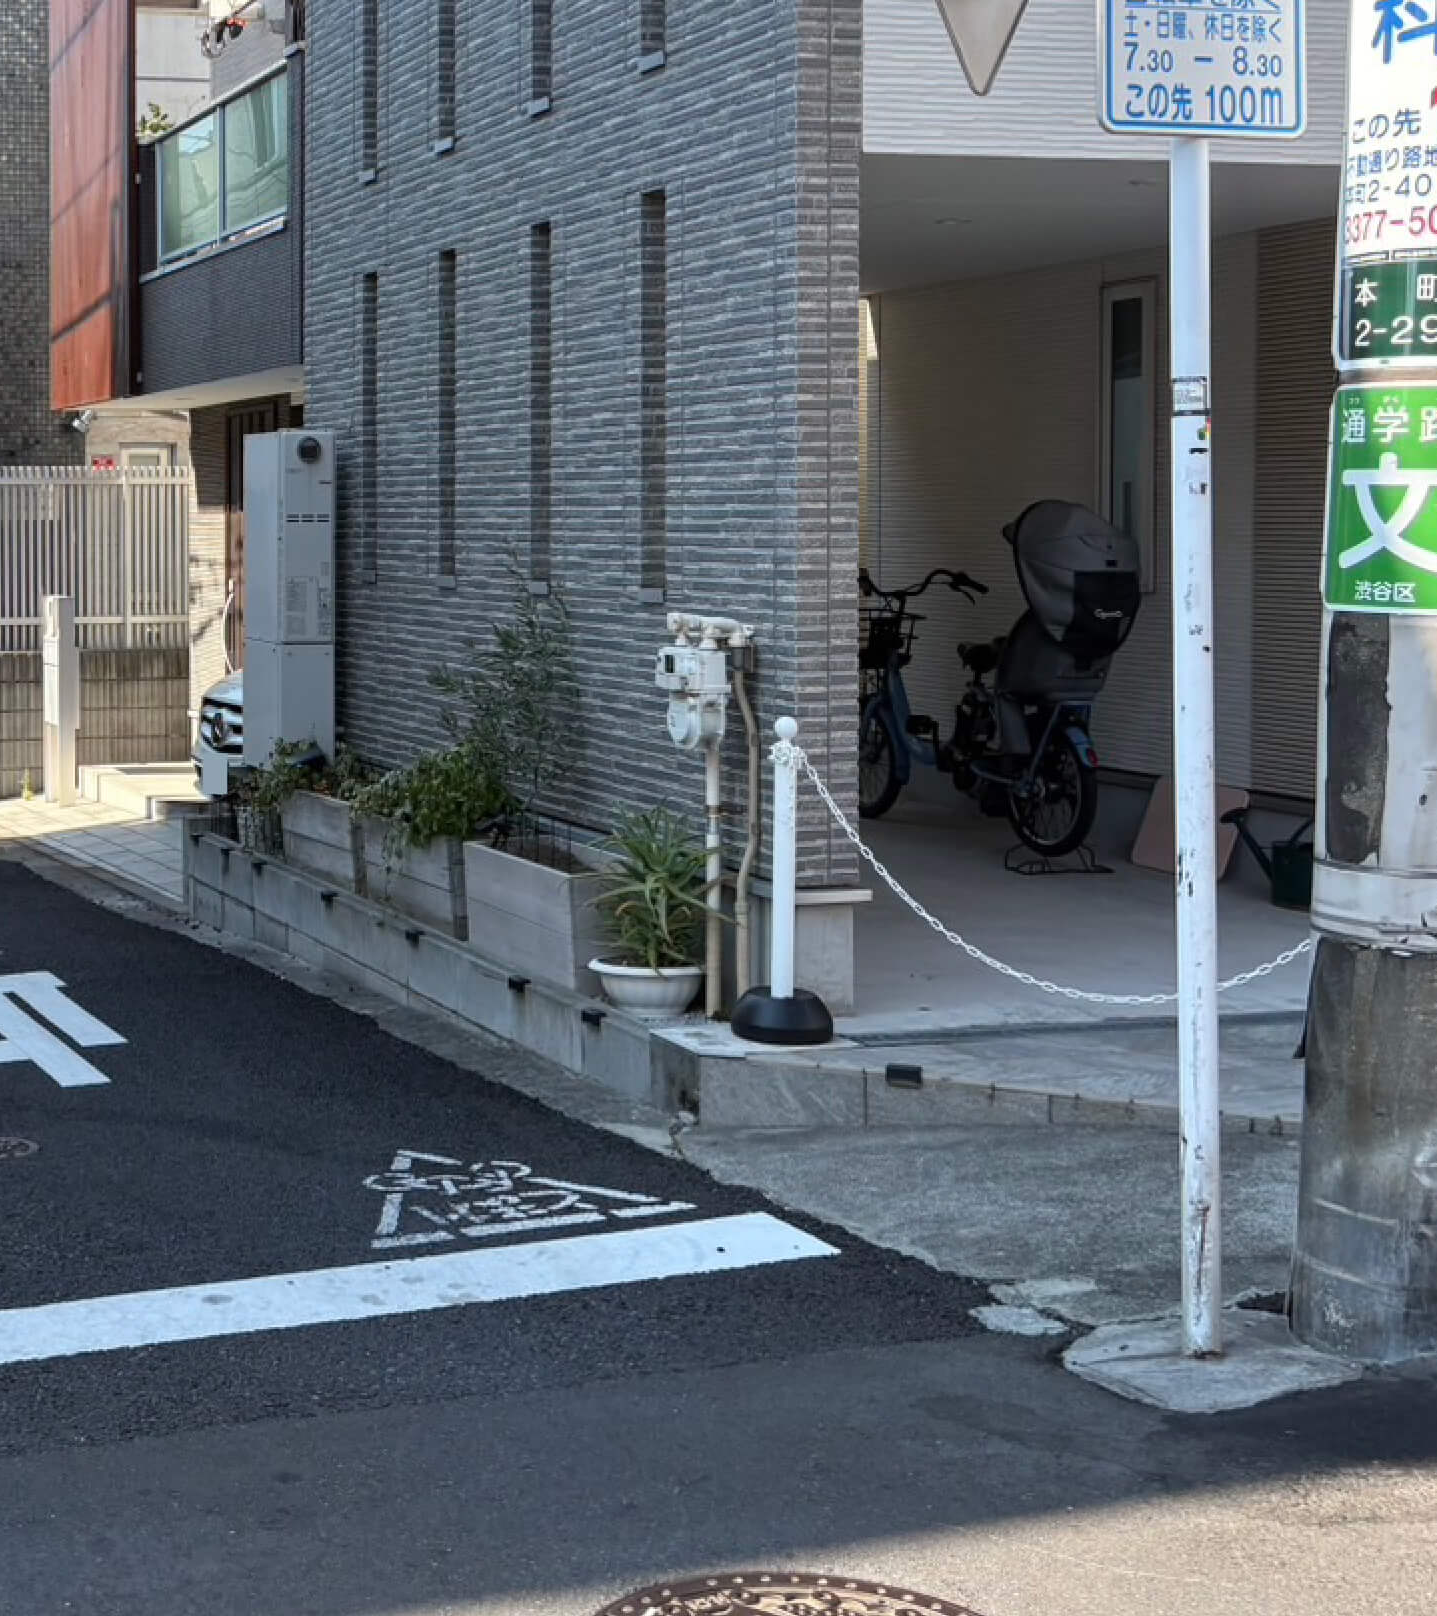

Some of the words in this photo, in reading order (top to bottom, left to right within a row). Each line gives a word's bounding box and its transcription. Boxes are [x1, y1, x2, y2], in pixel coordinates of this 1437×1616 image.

[1124, 41, 1174, 72] 7.30
[1232, 45, 1282, 77] 8.30
[1125, 82, 1193, 121] この先
[1205, 84, 1282, 125] 100m
[1352, 107, 1421, 144] この先
